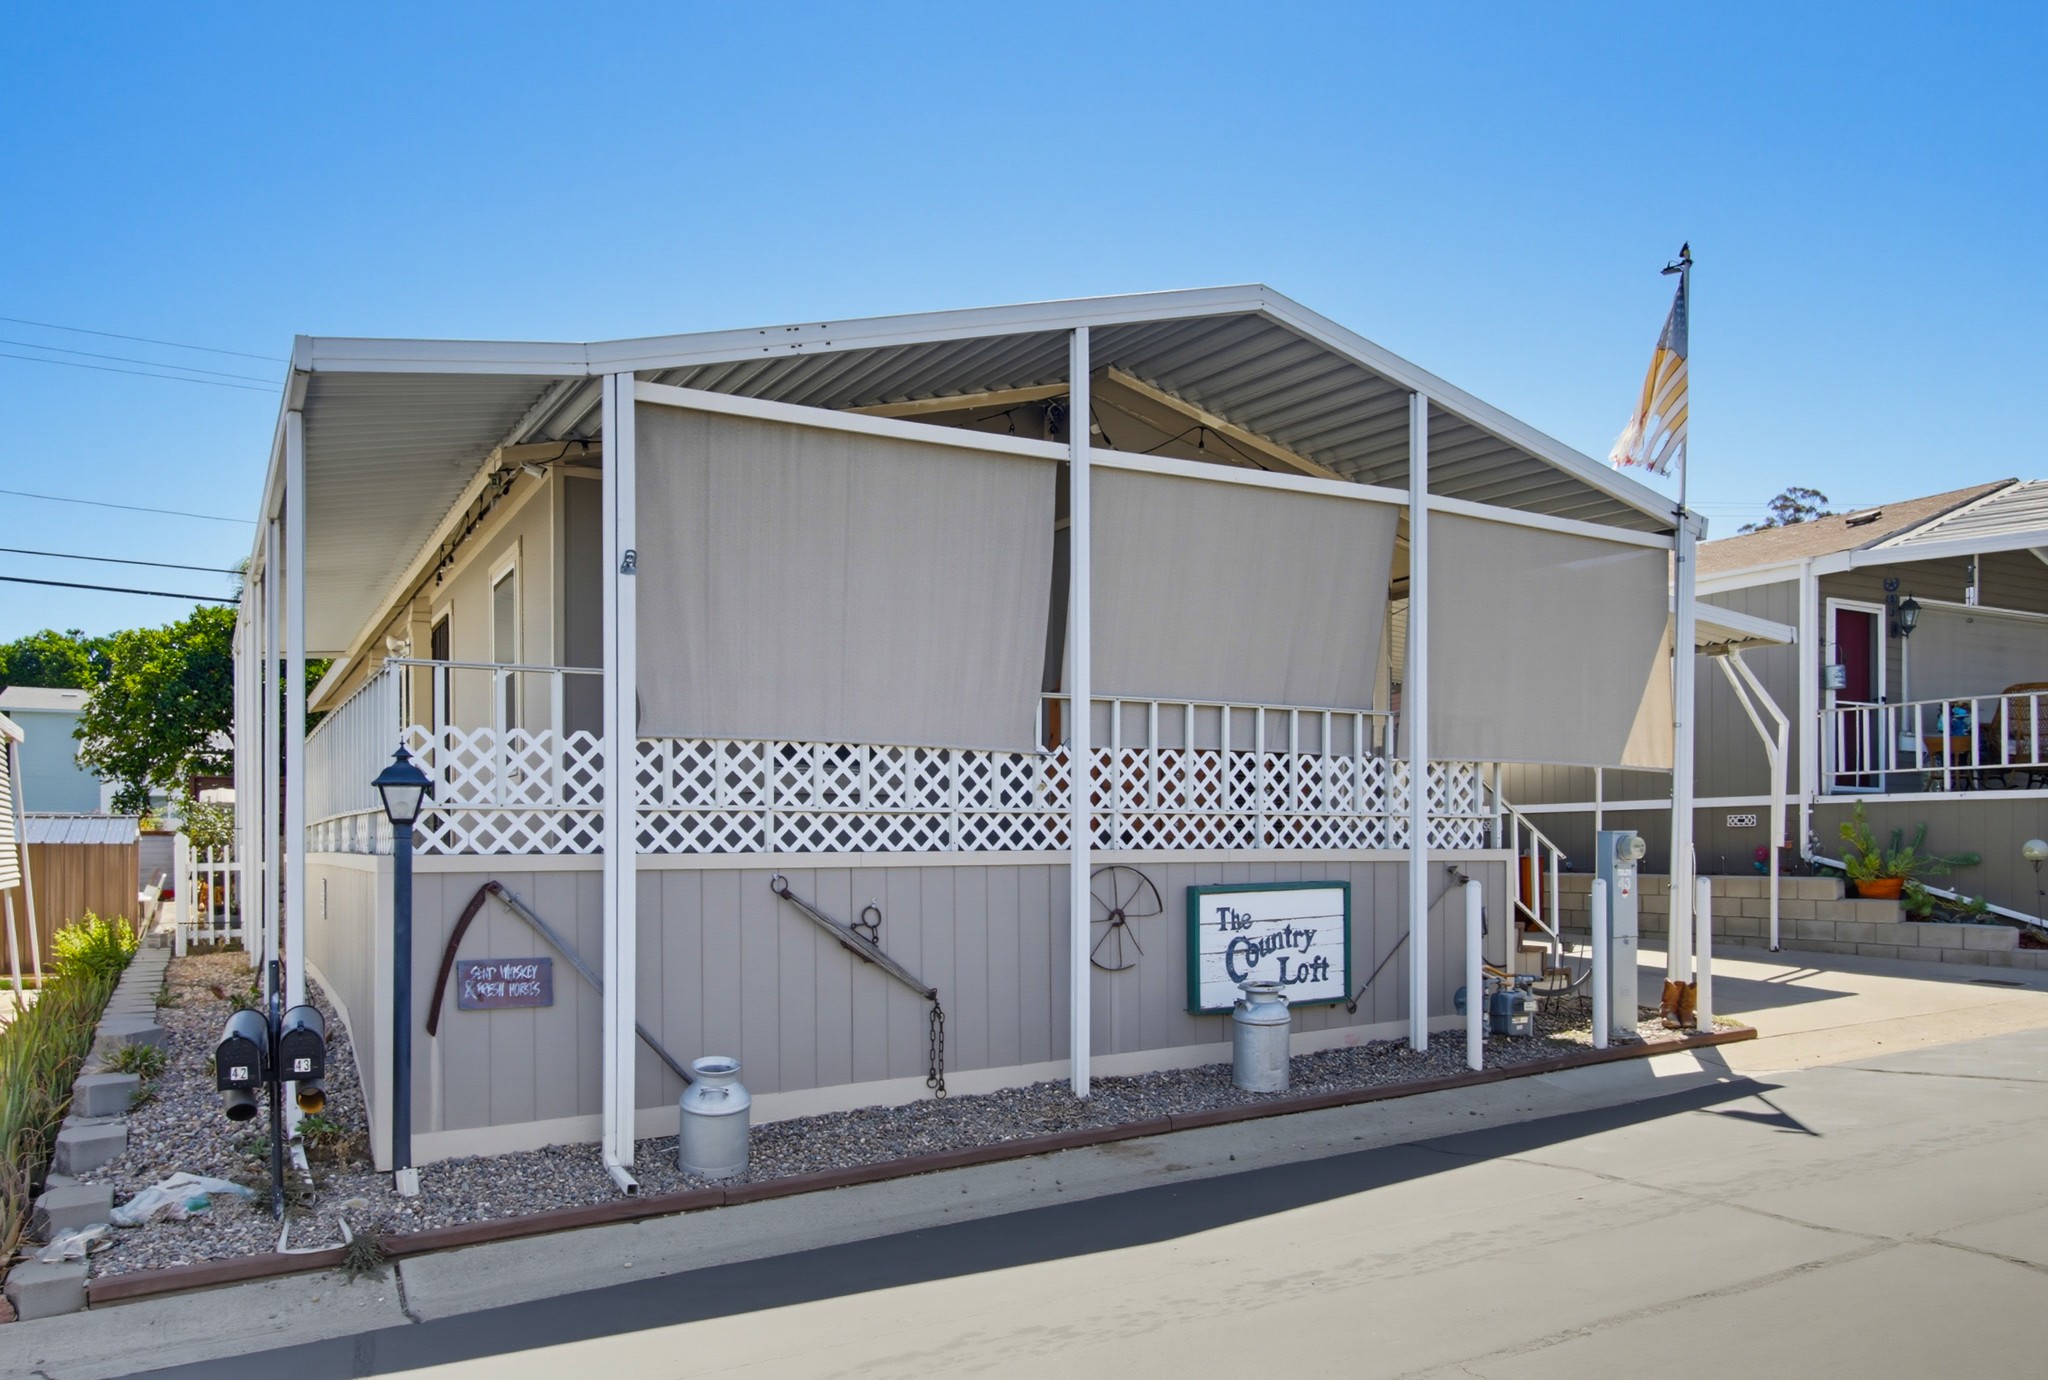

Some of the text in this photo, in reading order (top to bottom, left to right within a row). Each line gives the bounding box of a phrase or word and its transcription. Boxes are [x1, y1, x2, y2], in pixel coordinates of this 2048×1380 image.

[1216, 907, 1252, 931] The
[1226, 924, 1317, 983] Country
[500, 964, 538, 980] WHISKEY
[1277, 955, 1329, 984] Loft
[476, 982, 505, 997] FRESH
[509, 981, 541, 997] HORSES
[295, 1059, 310, 1071] 43
[232, 1068, 247, 1079] 42
